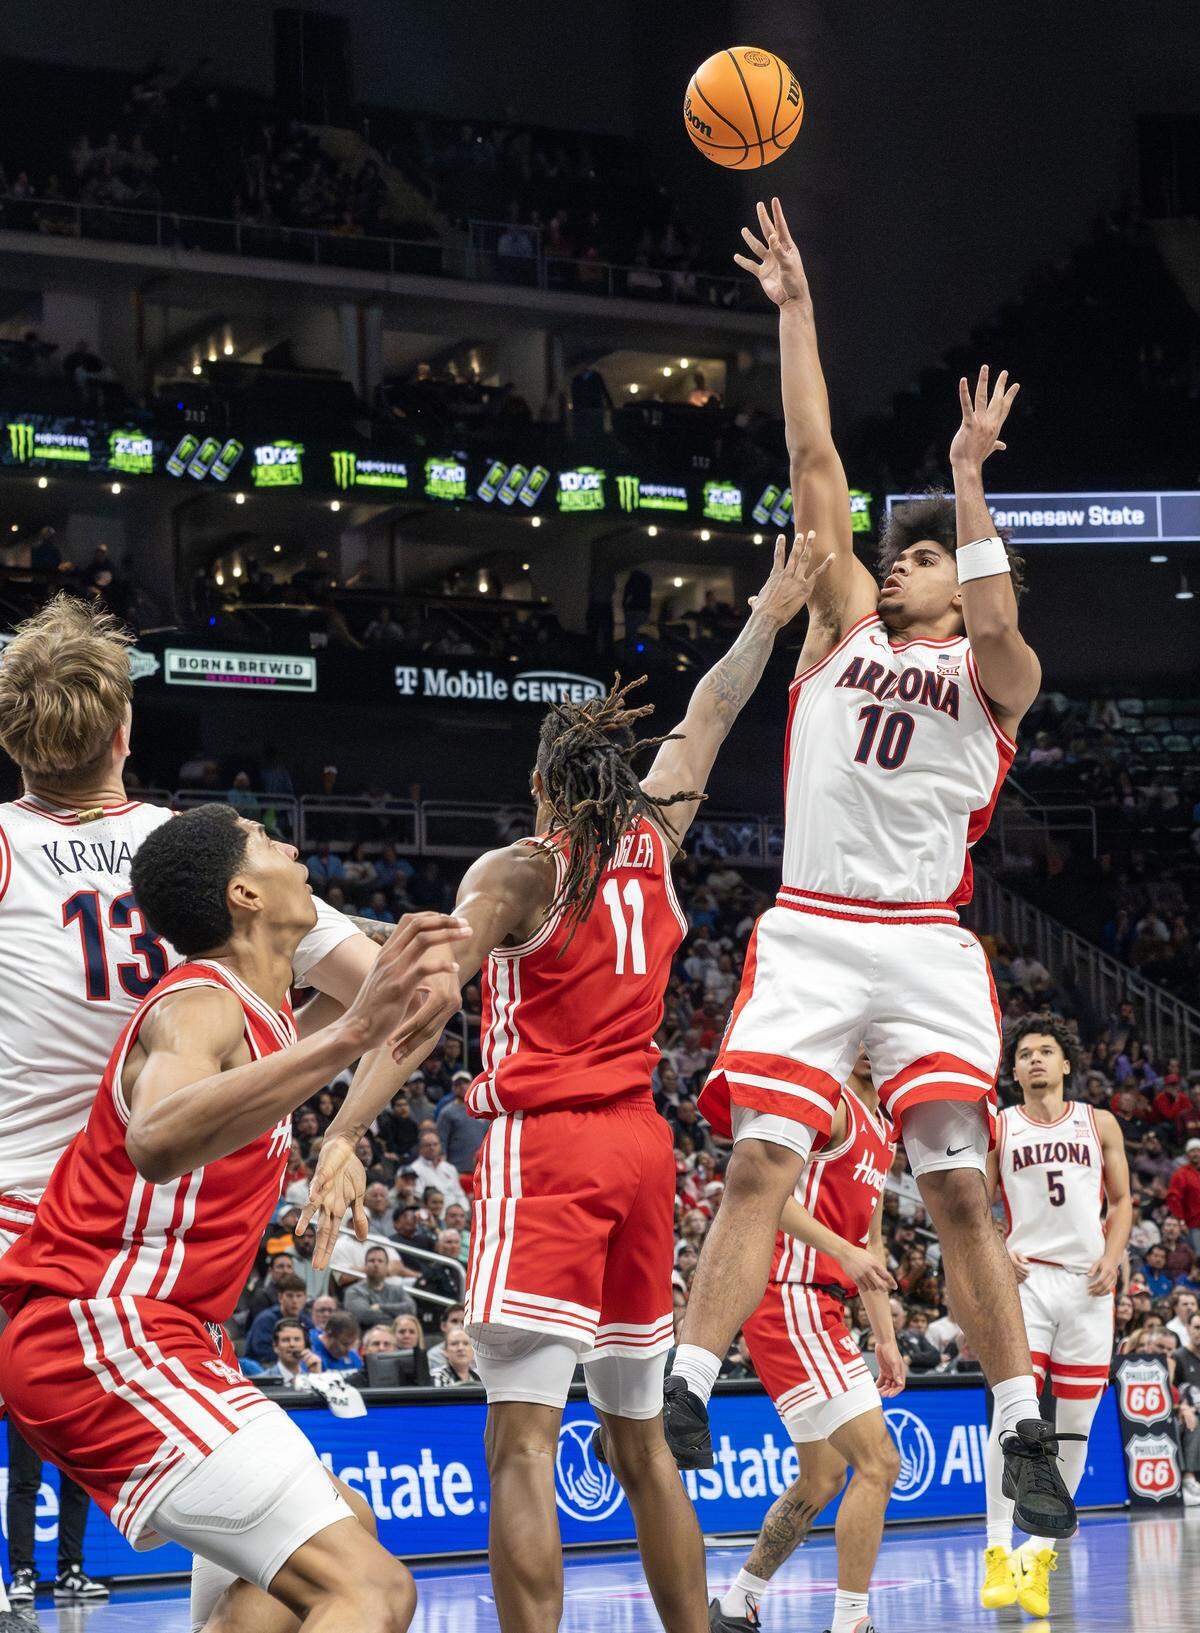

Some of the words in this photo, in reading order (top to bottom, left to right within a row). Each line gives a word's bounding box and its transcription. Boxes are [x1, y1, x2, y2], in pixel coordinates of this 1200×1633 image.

[1088, 505, 1145, 526] State
[178, 657, 221, 671] BORN
[225, 661, 234, 672] &
[238, 661, 303, 676] BREWED
[422, 668, 508, 700] Mobile
[512, 681, 599, 704] CENTER
[834, 656, 960, 721] ARIZONA
[853, 703, 915, 771] 10
[607, 833, 653, 872] UGLER
[602, 878, 647, 975] 11
[62, 890, 169, 1001] 13
[1012, 1142, 1091, 1172] ARIZONA
[1046, 1170, 1066, 1207] 5
[1130, 1387, 1160, 1412] 66
[321, 1448, 475, 1519] state
[1139, 1461, 1169, 1486] 66
